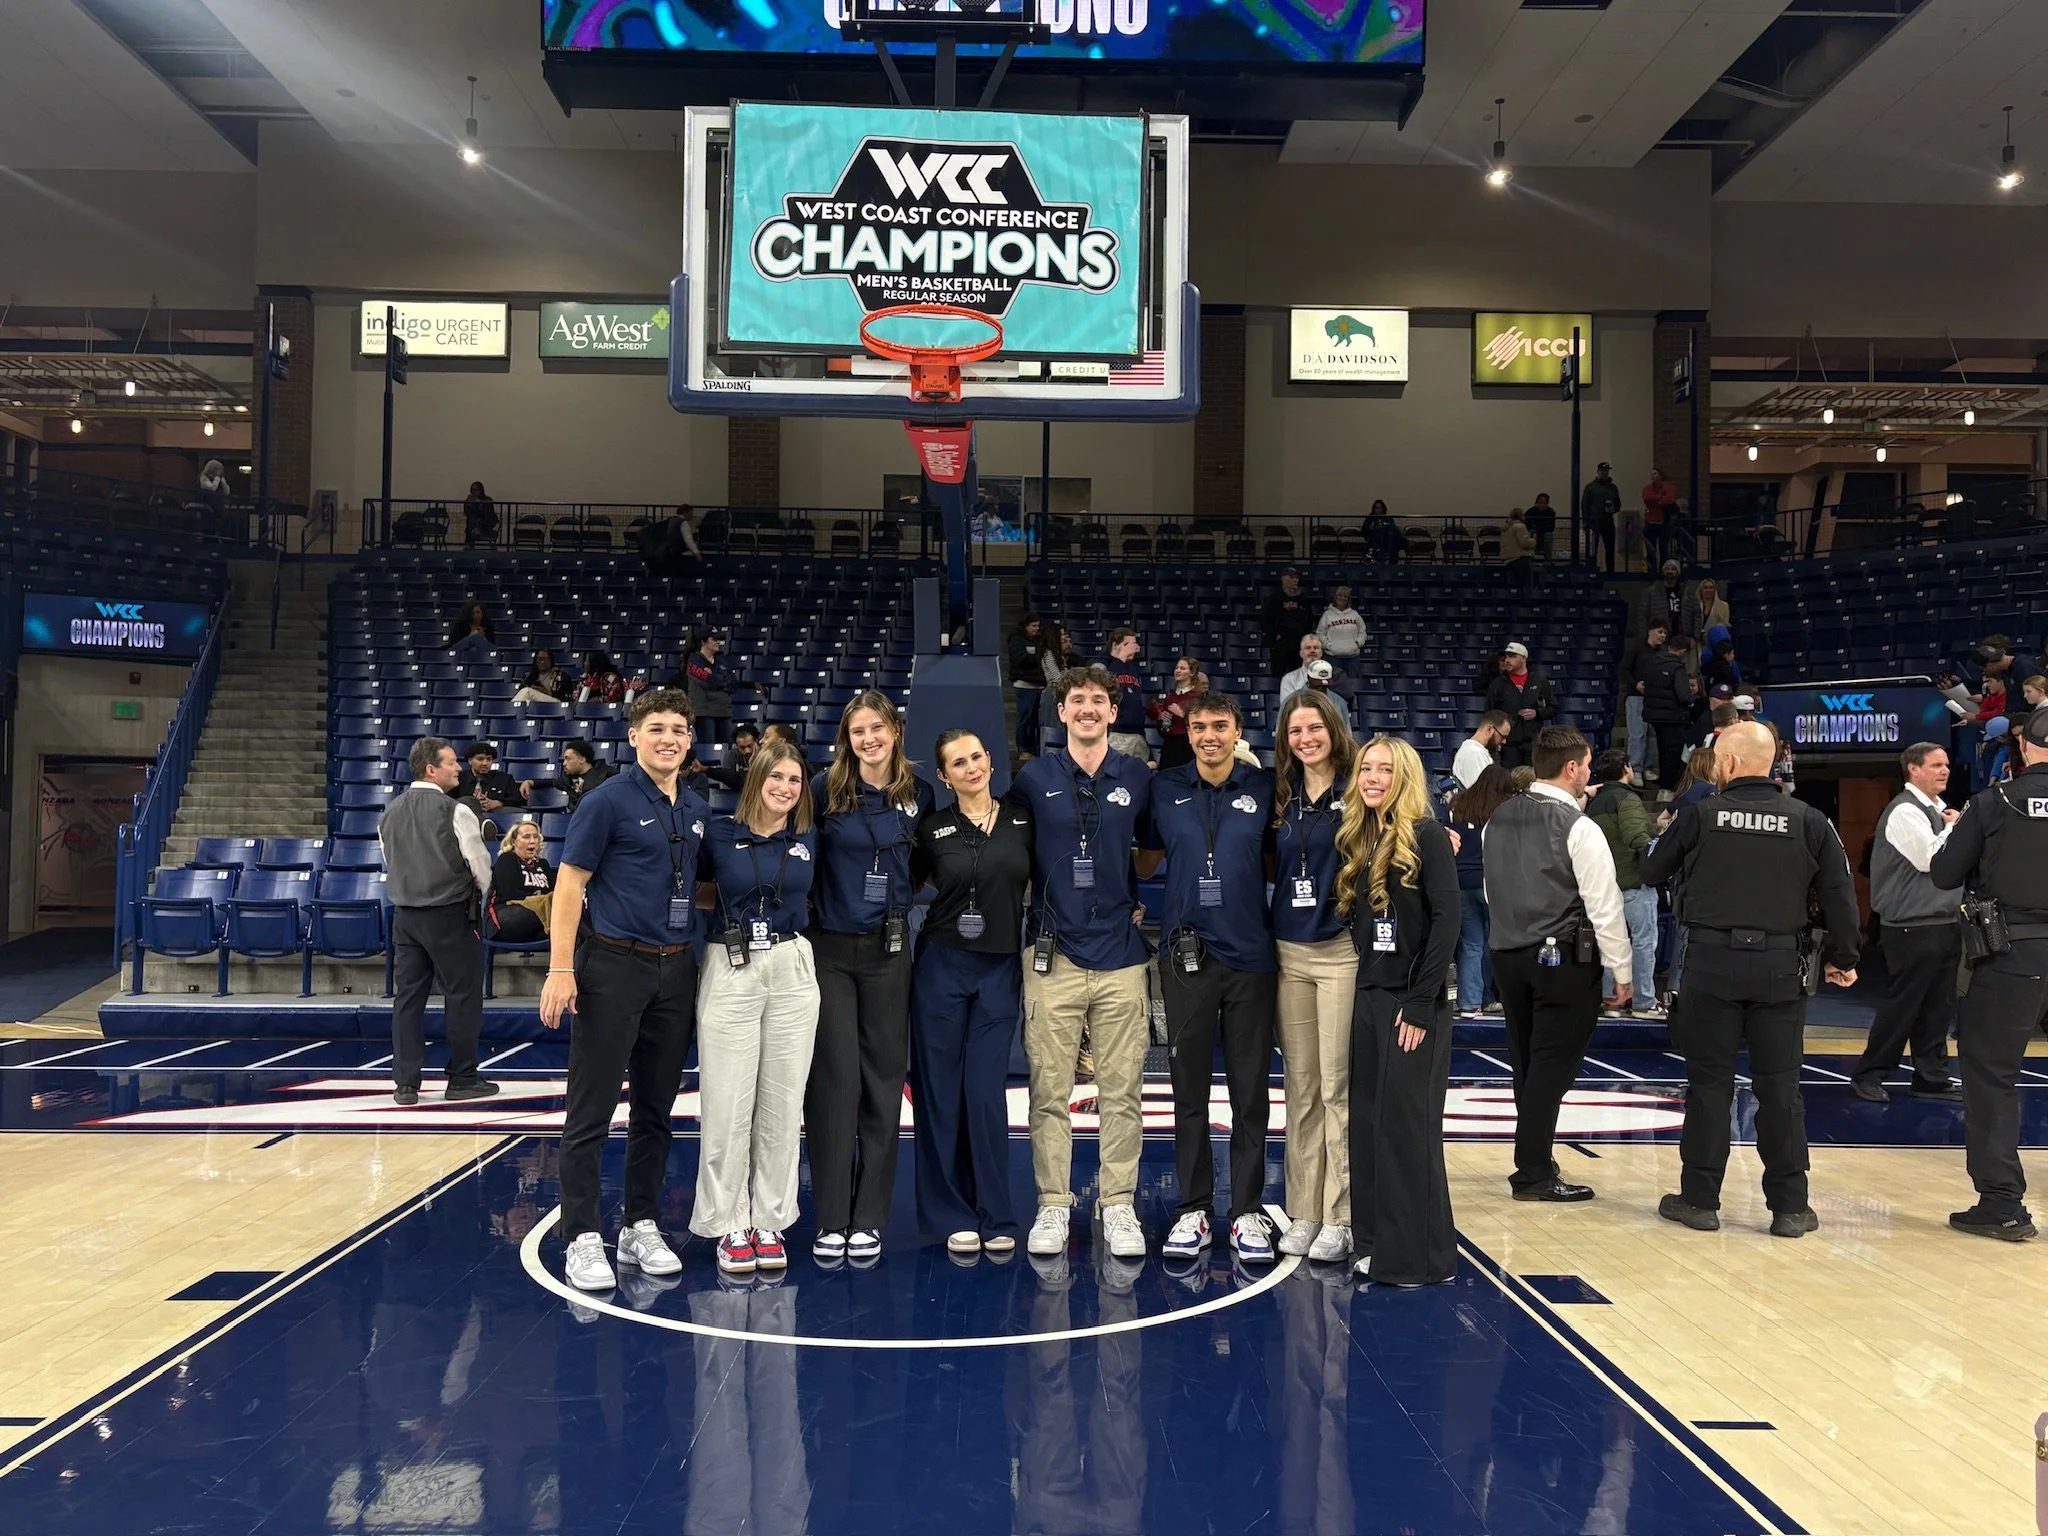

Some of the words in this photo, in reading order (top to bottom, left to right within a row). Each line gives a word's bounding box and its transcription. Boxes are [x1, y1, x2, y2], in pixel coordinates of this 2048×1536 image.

[867, 148, 1010, 205] WCC
[795, 201, 858, 221] WEST
[861, 204, 932, 226] COAST
[935, 208, 1080, 230] CONFERENCE
[757, 222, 1117, 287] CHAMPIONS
[857, 274, 908, 289] MEN'S
[911, 276, 1013, 292] BASKETBALL
[883, 289, 938, 302] REGULAR
[938, 292, 986, 303] SEASON
[436, 318, 502, 333] URGENT
[549, 313, 653, 349] AgWest
[435, 332, 479, 346] CARE
[593, 341, 617, 350] FARM
[617, 342, 648, 351] CREDIT
[1524, 337, 1586, 358] ICCU
[1327, 354, 1398, 364] DAVIDSON
[1058, 366, 1096, 374] CREDIT
[702, 379, 752, 392] SPALDING
[95, 601, 145, 620] WCC
[70, 618, 165, 650] CHAMPIONS
[1819, 693, 1875, 712] WCC
[1794, 712, 1901, 744] CHAMPIONS
[1717, 810, 1789, 833] POLICE
[932, 825, 958, 840] ZAGS
[1295, 880, 1313, 895] ES
[752, 921, 768, 937] ES
[1376, 922, 1393, 938] ES
